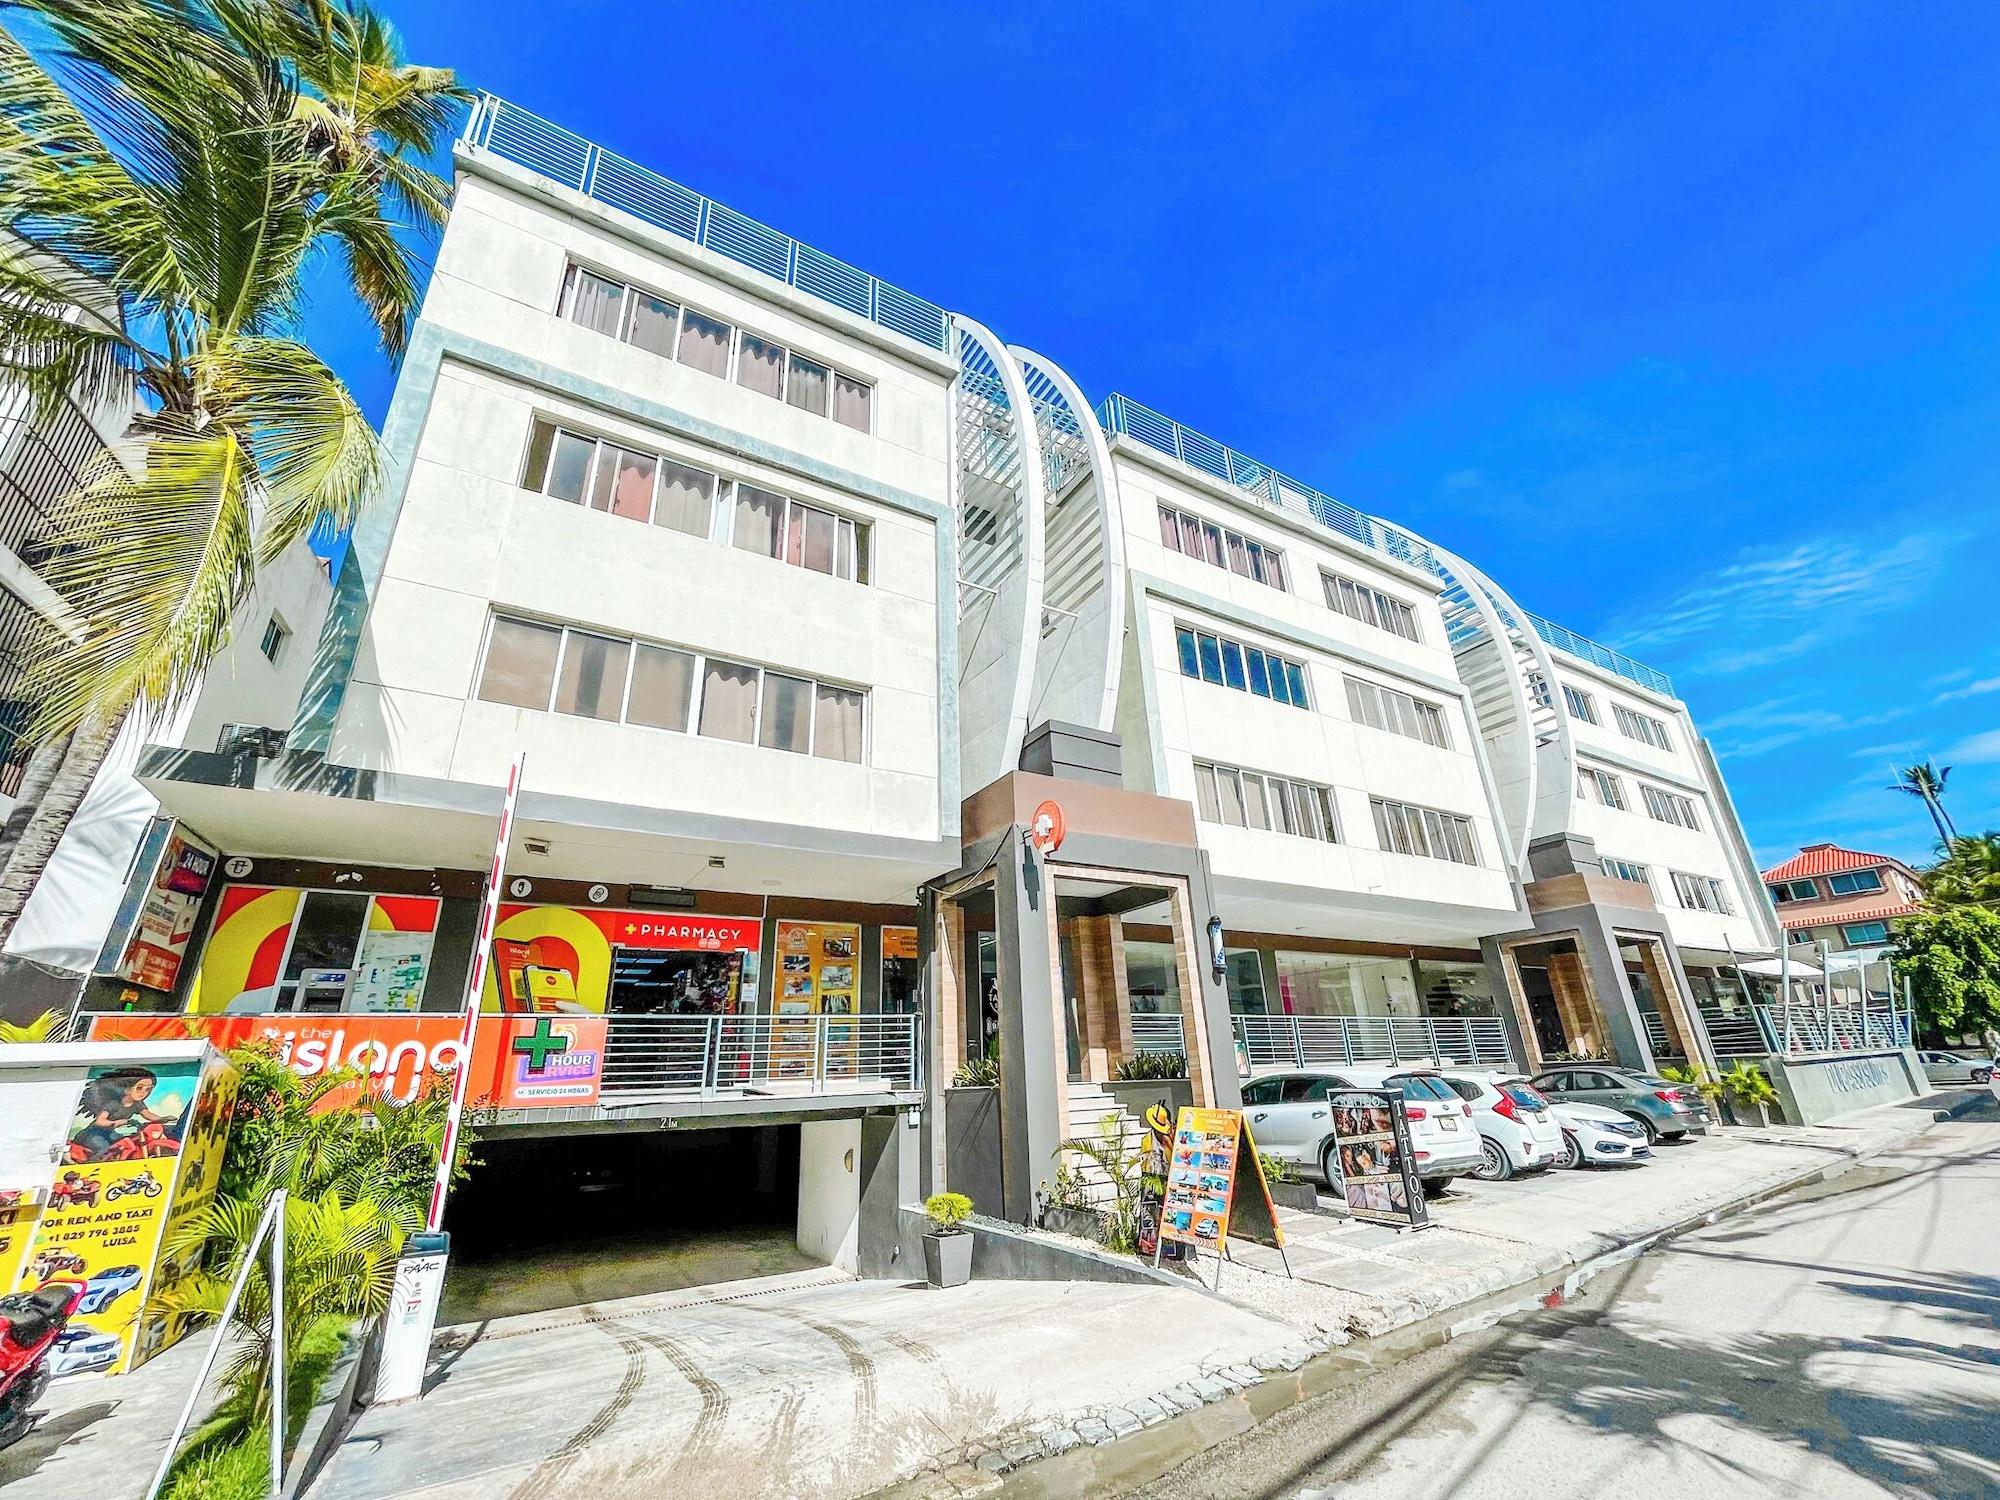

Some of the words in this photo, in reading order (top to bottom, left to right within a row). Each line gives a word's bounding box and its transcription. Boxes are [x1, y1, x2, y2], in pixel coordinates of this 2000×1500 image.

[640, 924, 741, 940] PHARMACY
[301, 1027, 332, 1039] the
[279, 1028, 468, 1092] island
[552, 1055, 592, 1066] HOUR
[527, 1088, 558, 1096] SERVICIO
[1393, 1099, 1424, 1214] TATTOO
[67, 1215, 92, 1226] REN
[95, 1212, 122, 1223] AND
[126, 1208, 153, 1219] TAXI
[88, 1228, 108, 1238] 796
[103, 1236, 137, 1248] LUISA
[403, 1262, 440, 1274] FAAC
